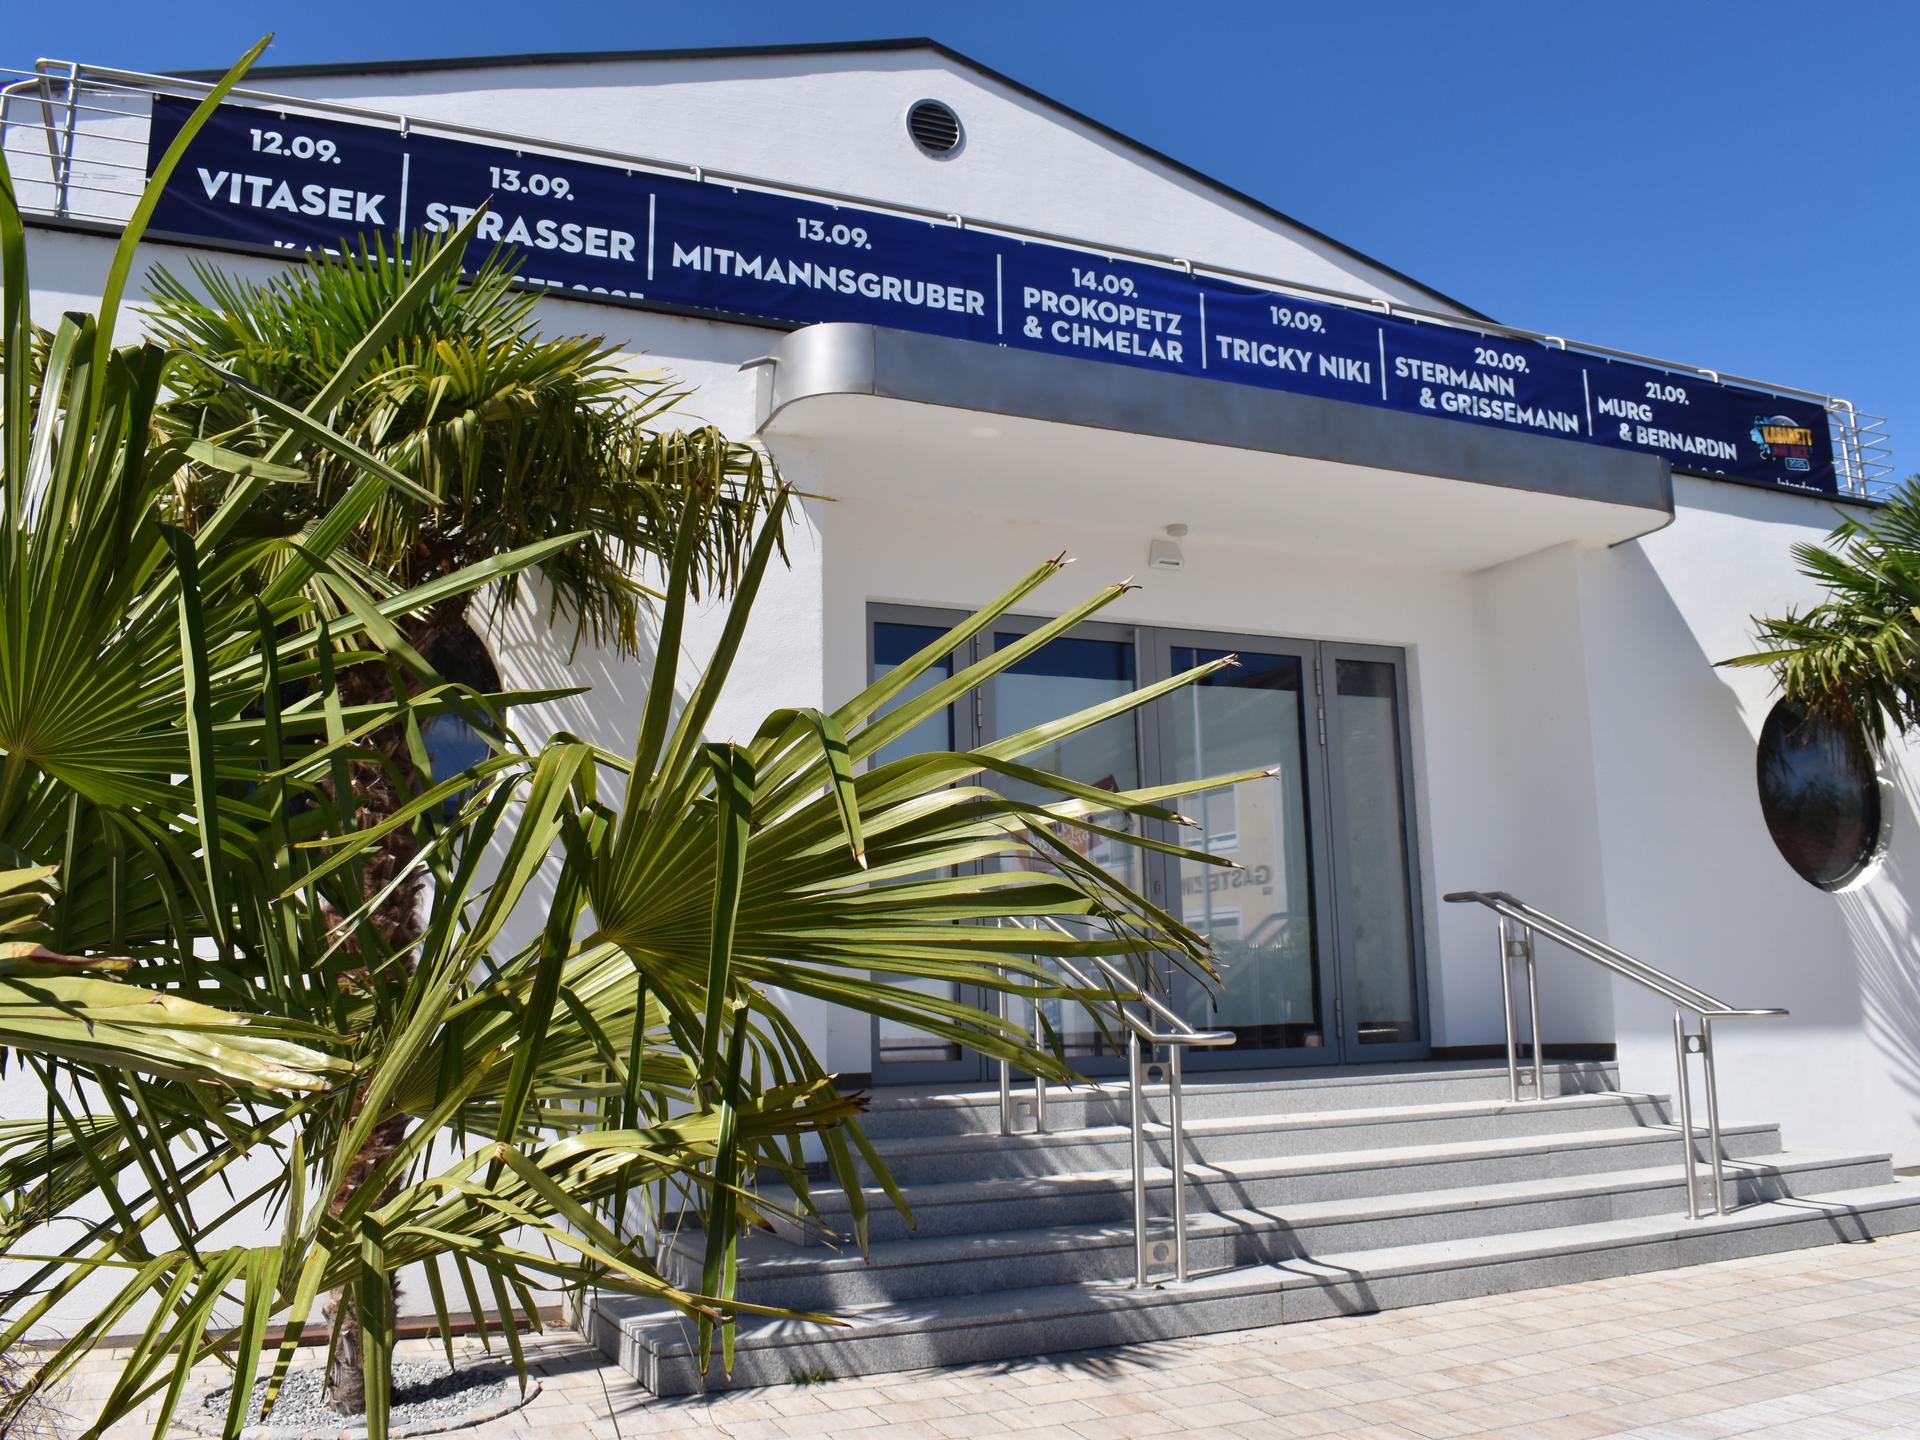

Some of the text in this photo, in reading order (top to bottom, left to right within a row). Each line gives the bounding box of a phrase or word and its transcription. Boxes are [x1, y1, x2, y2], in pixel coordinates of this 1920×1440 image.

[251, 129, 340, 163] 12.09.
[197, 168, 385, 224] VITASEK
[490, 167, 574, 200] 13.09.
[424, 202, 634, 261] STRASSER
[798, 218, 871, 249] 13.09.
[673, 242, 984, 315] MITMANNSGRUBER
[1072, 268, 1137, 298] 14.09.
[1024, 287, 1181, 335] PROKOPETZ
[1271, 306, 1325, 333] 19.09.
[1024, 316, 1182, 362] & CHMELAR
[1216, 336, 1370, 384] TRICKY NIKI
[1395, 357, 1514, 396] STERMANN
[1475, 348, 1529, 373] 20.09.
[1420, 388, 1578, 432] & GRISSEMANN
[1599, 397, 1652, 422] MURG
[1646, 382, 1689, 405] 21.09.
[1619, 423, 1737, 460] & BERNARDIN
